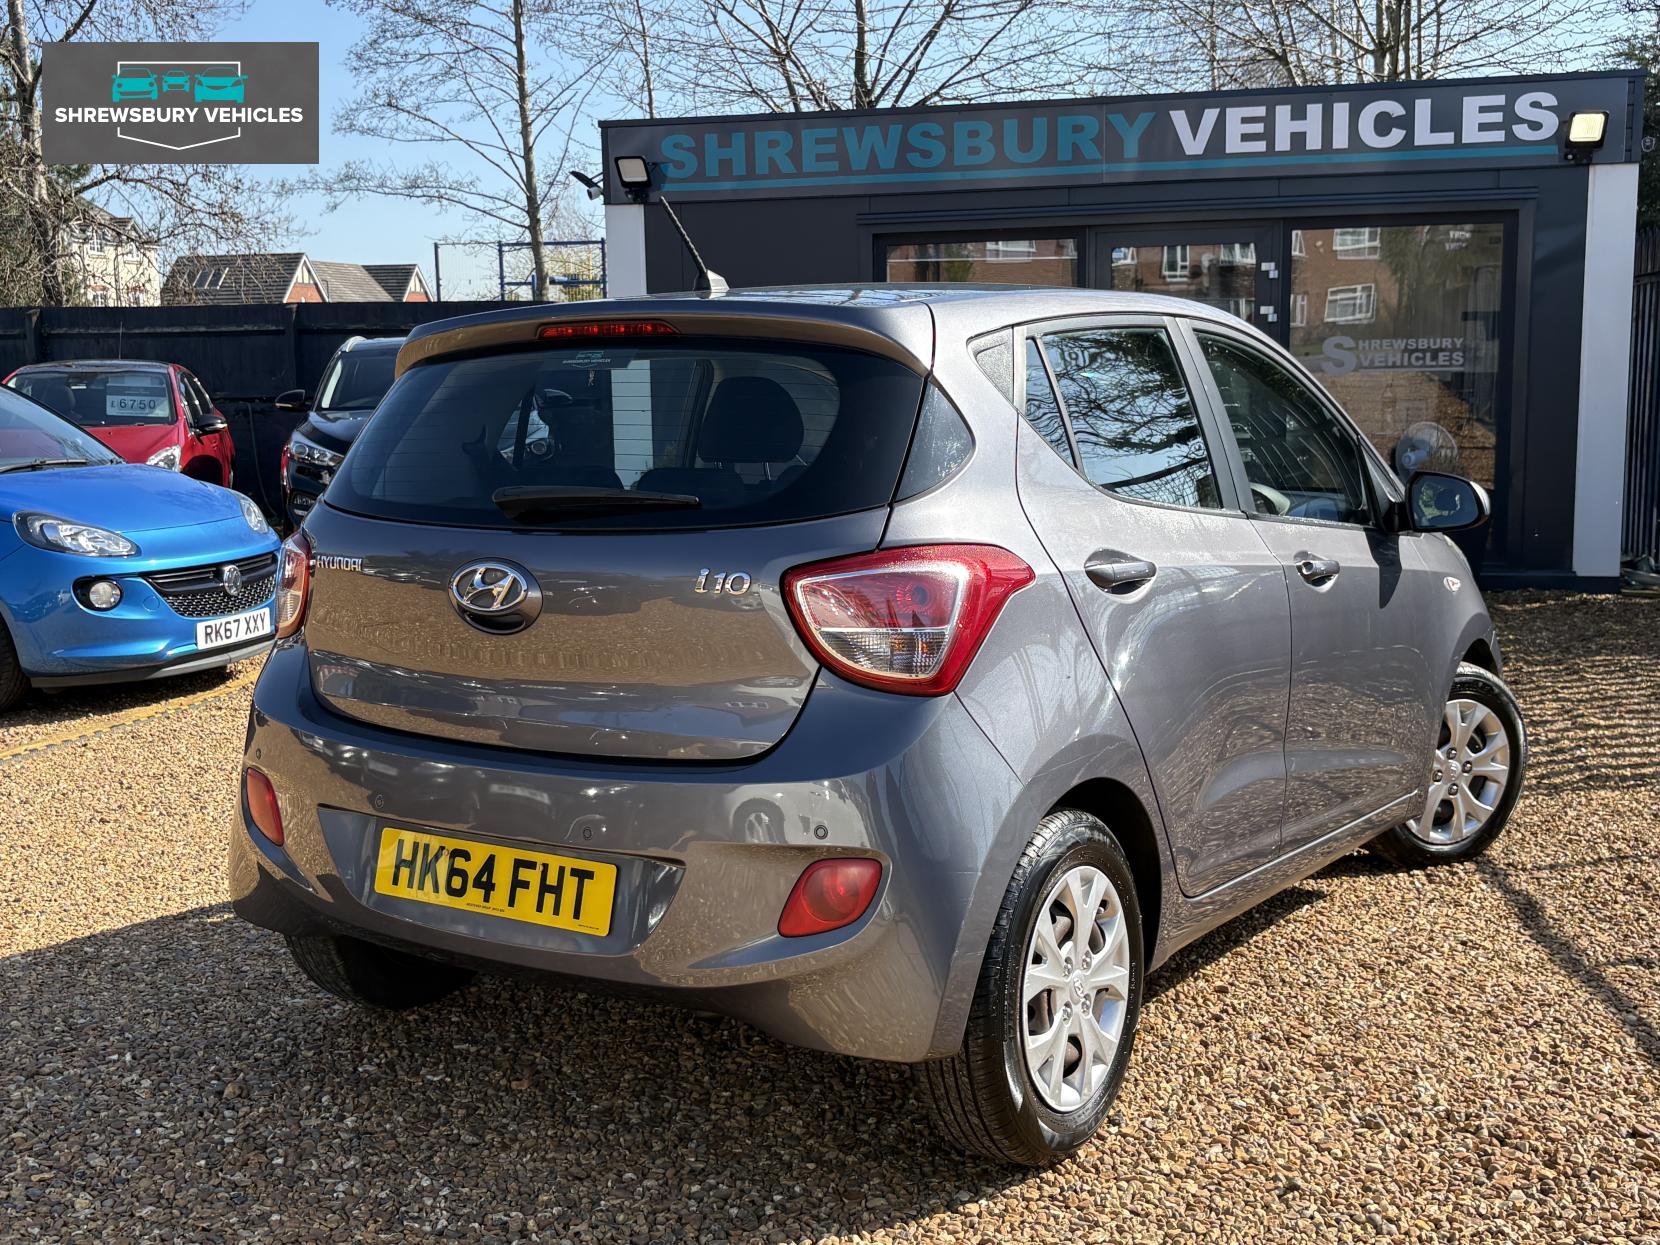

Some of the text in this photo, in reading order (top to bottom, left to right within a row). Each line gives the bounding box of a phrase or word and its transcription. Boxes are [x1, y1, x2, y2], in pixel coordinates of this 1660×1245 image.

[660, 91, 1559, 180] SHREWSBURY VEHICLES
[1360, 351, 1465, 367] VEHICLES
[317, 555, 363, 571] HYUNDAI
[694, 568, 751, 595] i10
[204, 611, 266, 644] RK67 XXY
[391, 838, 595, 920] HK64 FHT
